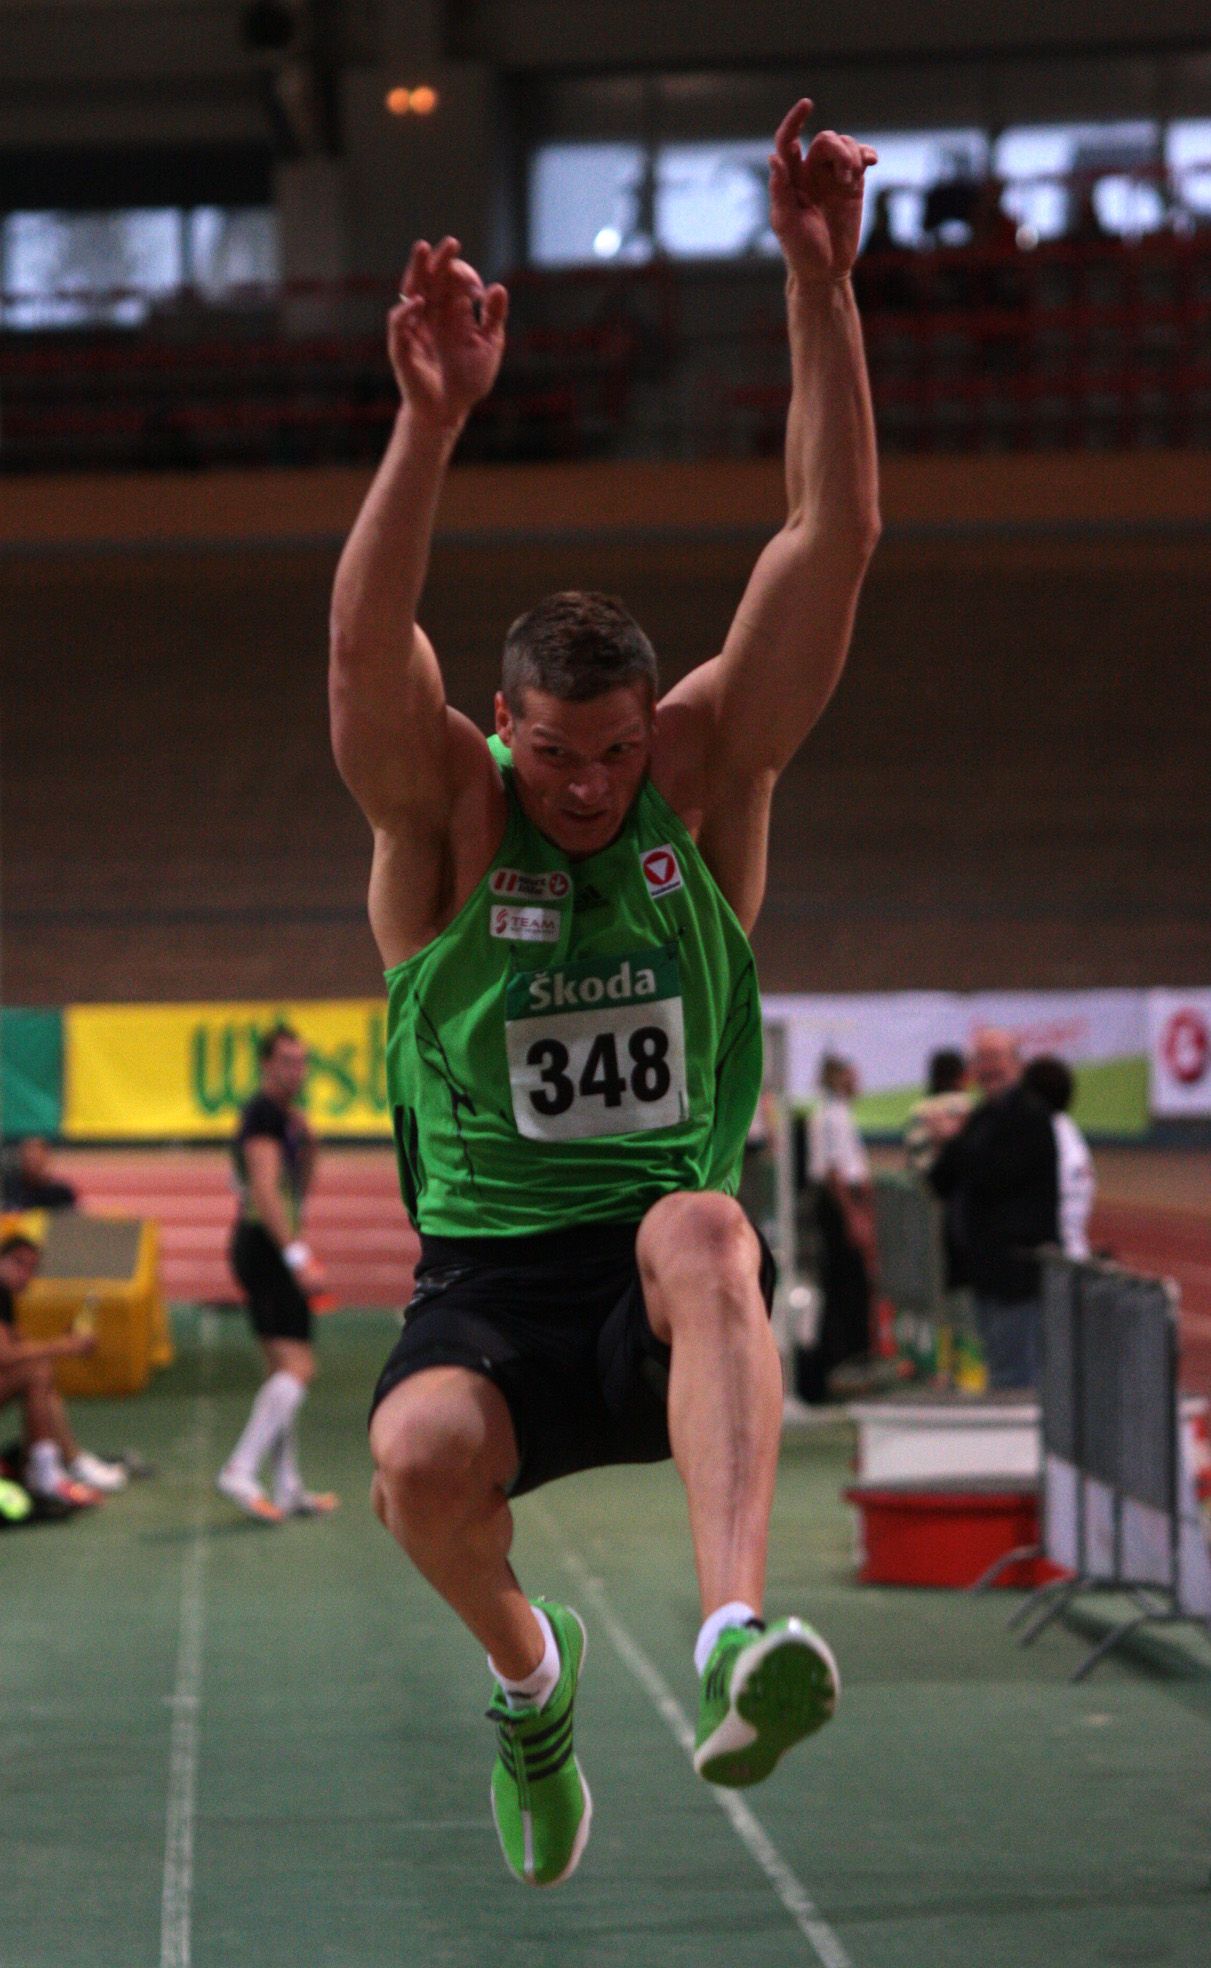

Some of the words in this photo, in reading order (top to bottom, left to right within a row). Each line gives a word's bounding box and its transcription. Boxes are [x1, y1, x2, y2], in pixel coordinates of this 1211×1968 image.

[511, 916, 556, 929] TEAM
[529, 961, 656, 1010] Škoda
[526, 1026, 671, 1116] 348
